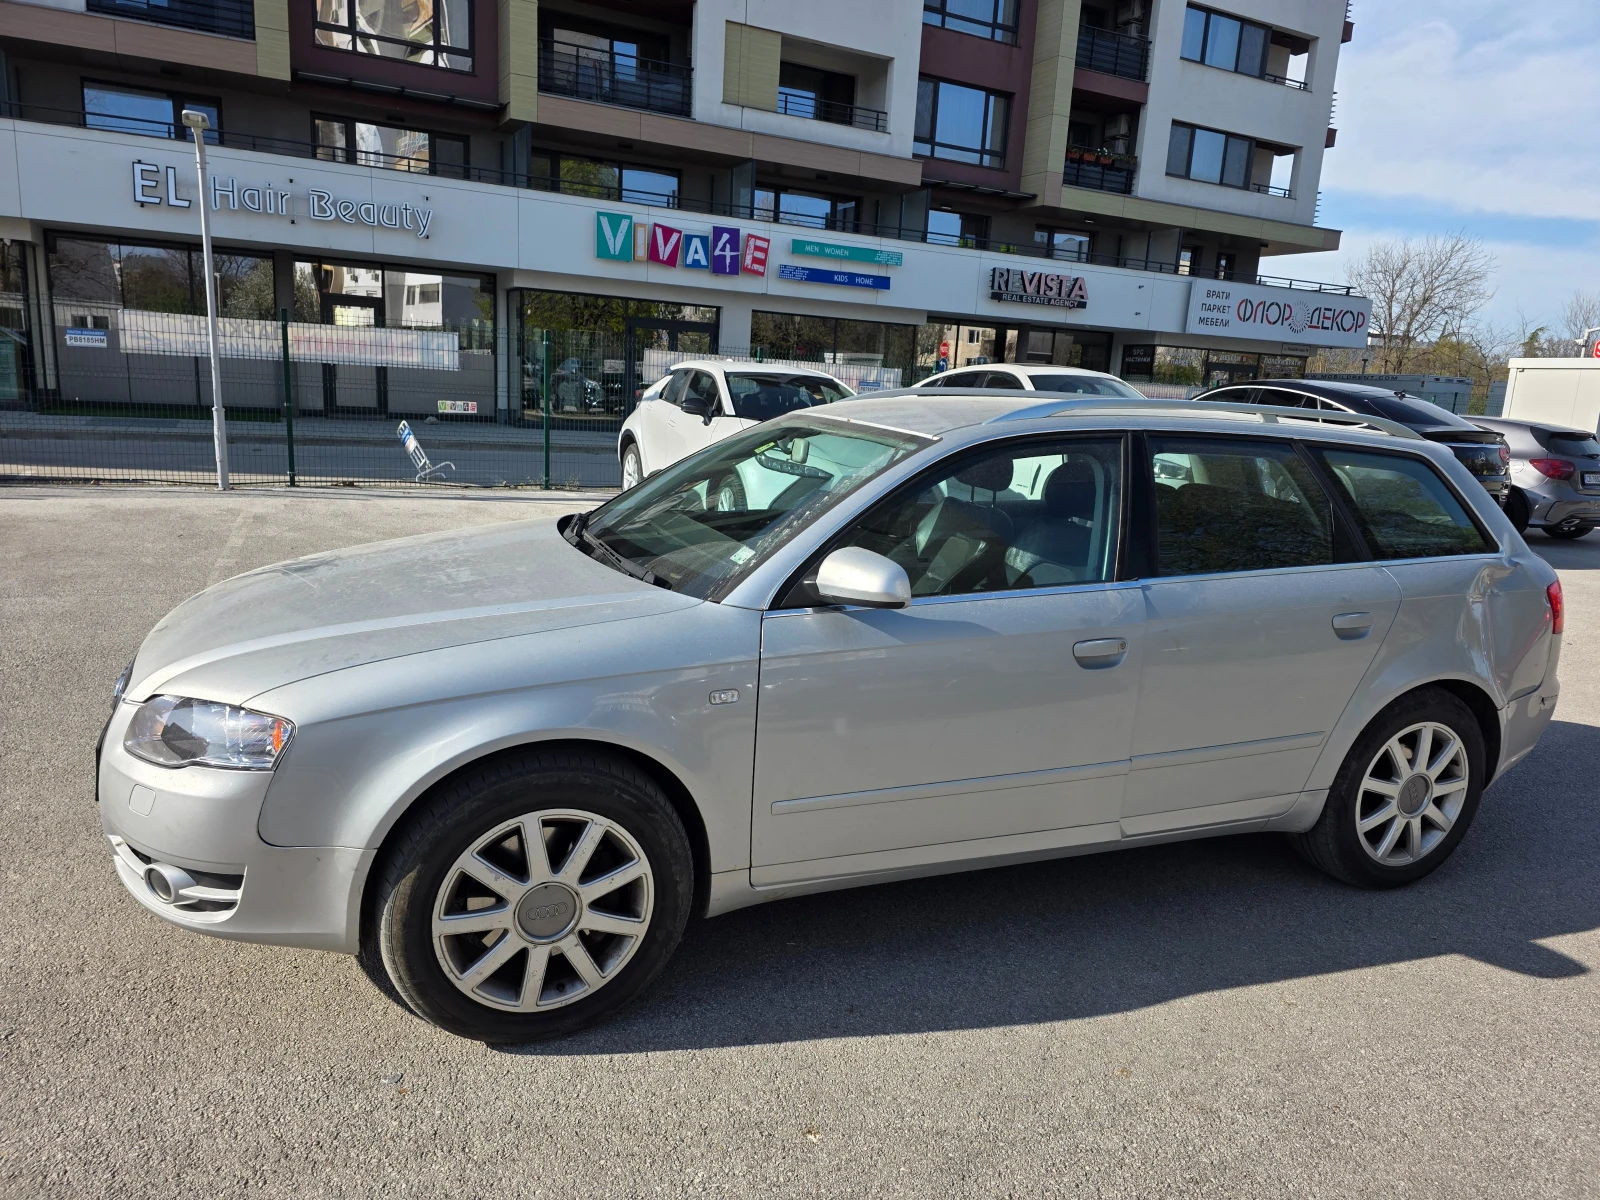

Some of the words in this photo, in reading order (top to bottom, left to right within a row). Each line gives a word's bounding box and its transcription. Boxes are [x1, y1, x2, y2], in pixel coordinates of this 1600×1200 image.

[132, 161, 192, 208] EL
[211, 173, 290, 214] Hair
[309, 188, 433, 238] Beauty
[598, 214, 769, 274] VIVA4E
[805, 244, 819, 253] MEN
[825, 247, 849, 256] WOMEN
[834, 274, 849, 283] KIDS
[855, 276, 874, 285] HOME
[991, 267, 1089, 300] REVISTA
[1002, 293, 1021, 302] REAL
[1023, 295, 1049, 305] ESTATE
[1050, 298, 1079, 308] AGENCY
[1206, 289, 1231, 301] ВРАТИ
[1201, 302, 1231, 314] ПАРКЕТ
[1198, 316, 1230, 328] МЕБЕЛИ
[1308, 306, 1366, 333] ДЕКОР
